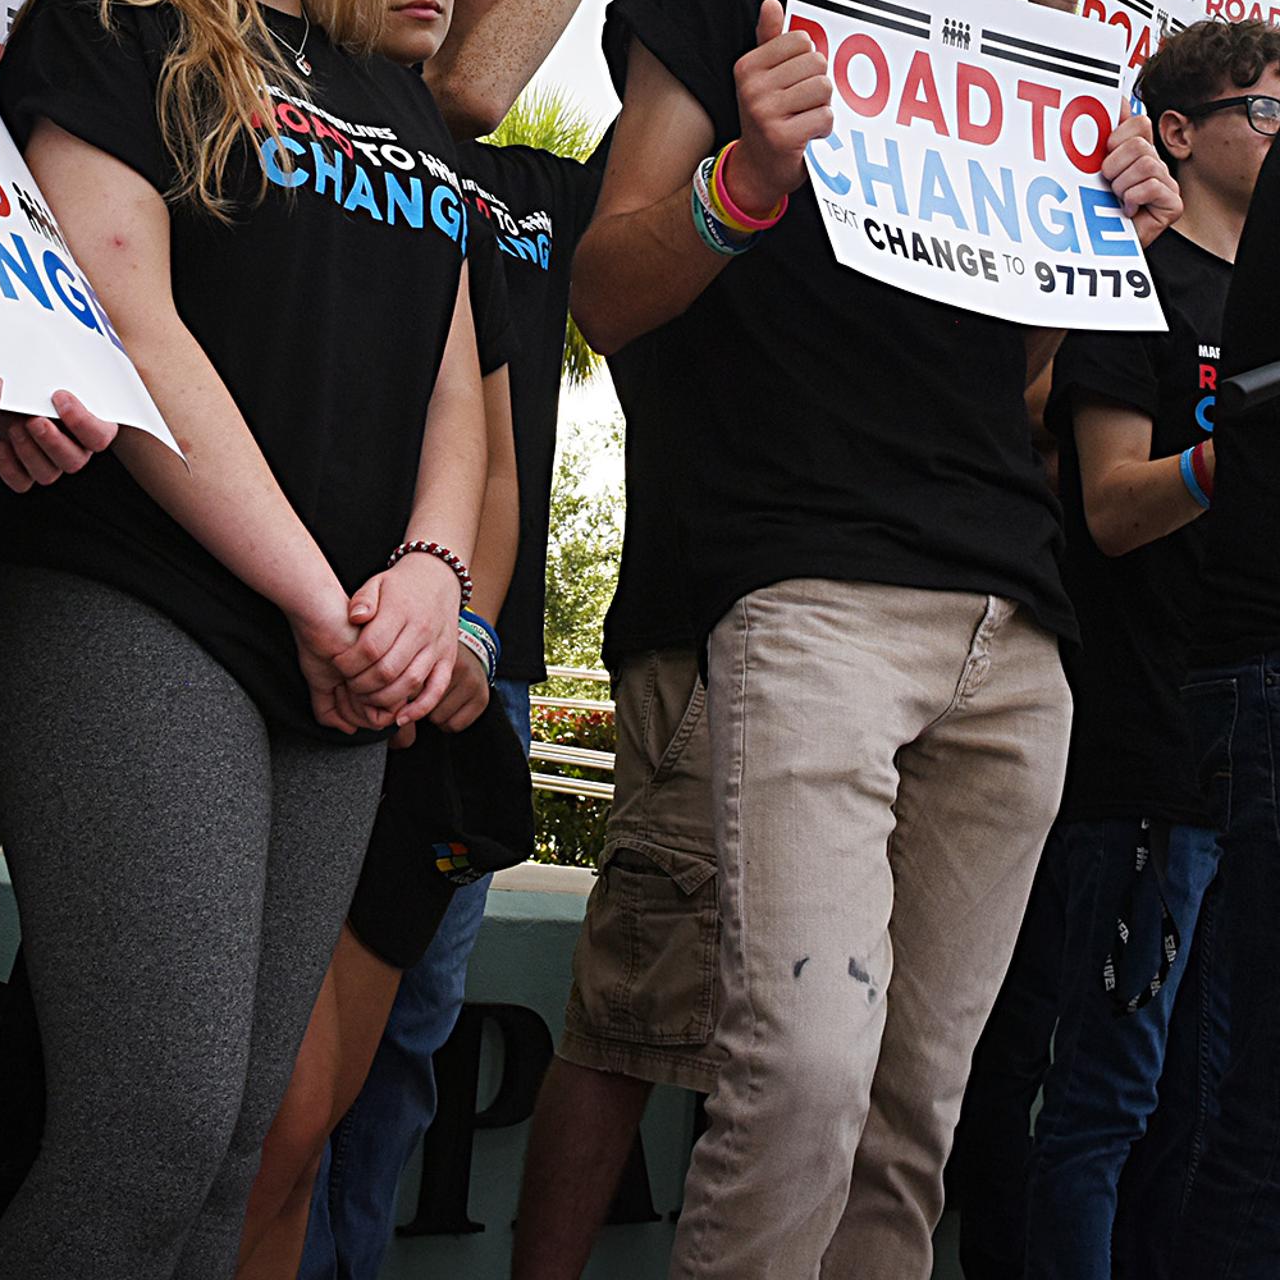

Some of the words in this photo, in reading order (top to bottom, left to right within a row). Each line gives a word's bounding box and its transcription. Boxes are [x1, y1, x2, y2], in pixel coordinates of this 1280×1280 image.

[351, 140, 415, 171] TO
[1017, 78, 1113, 175] TO
[259, 135, 466, 258] CHANG
[490, 206, 519, 236] TO
[806, 130, 1140, 258] CHANGE
[822, 198, 860, 229] TEXT
[864, 218, 1000, 283] CHANGE
[1003, 253, 1025, 276] TO
[1034, 260, 1151, 299] 97779
